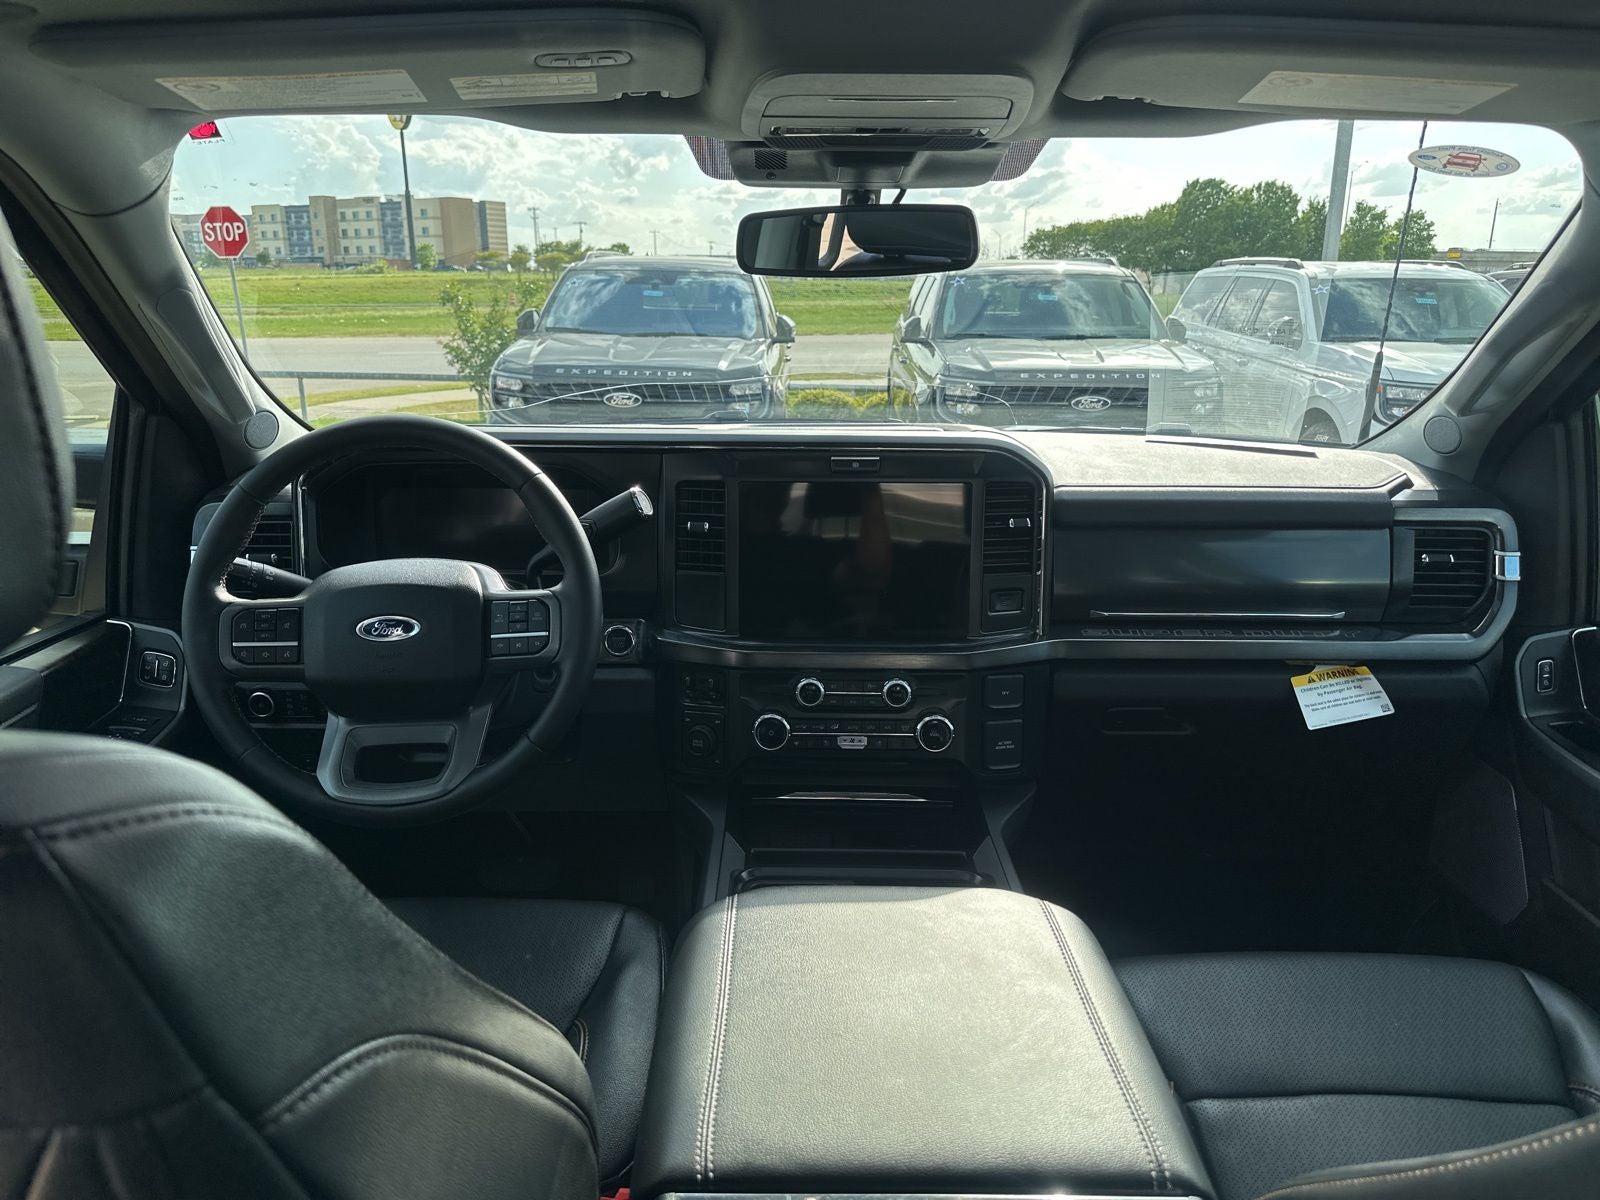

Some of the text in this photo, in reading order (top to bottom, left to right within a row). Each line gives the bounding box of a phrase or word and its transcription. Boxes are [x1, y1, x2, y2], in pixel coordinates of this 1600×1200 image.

[204, 222, 244, 242] STOP
[555, 367, 693, 377] EXPEDITION
[371, 621, 406, 636] Ford
[1316, 668, 1361, 681] WARNING
